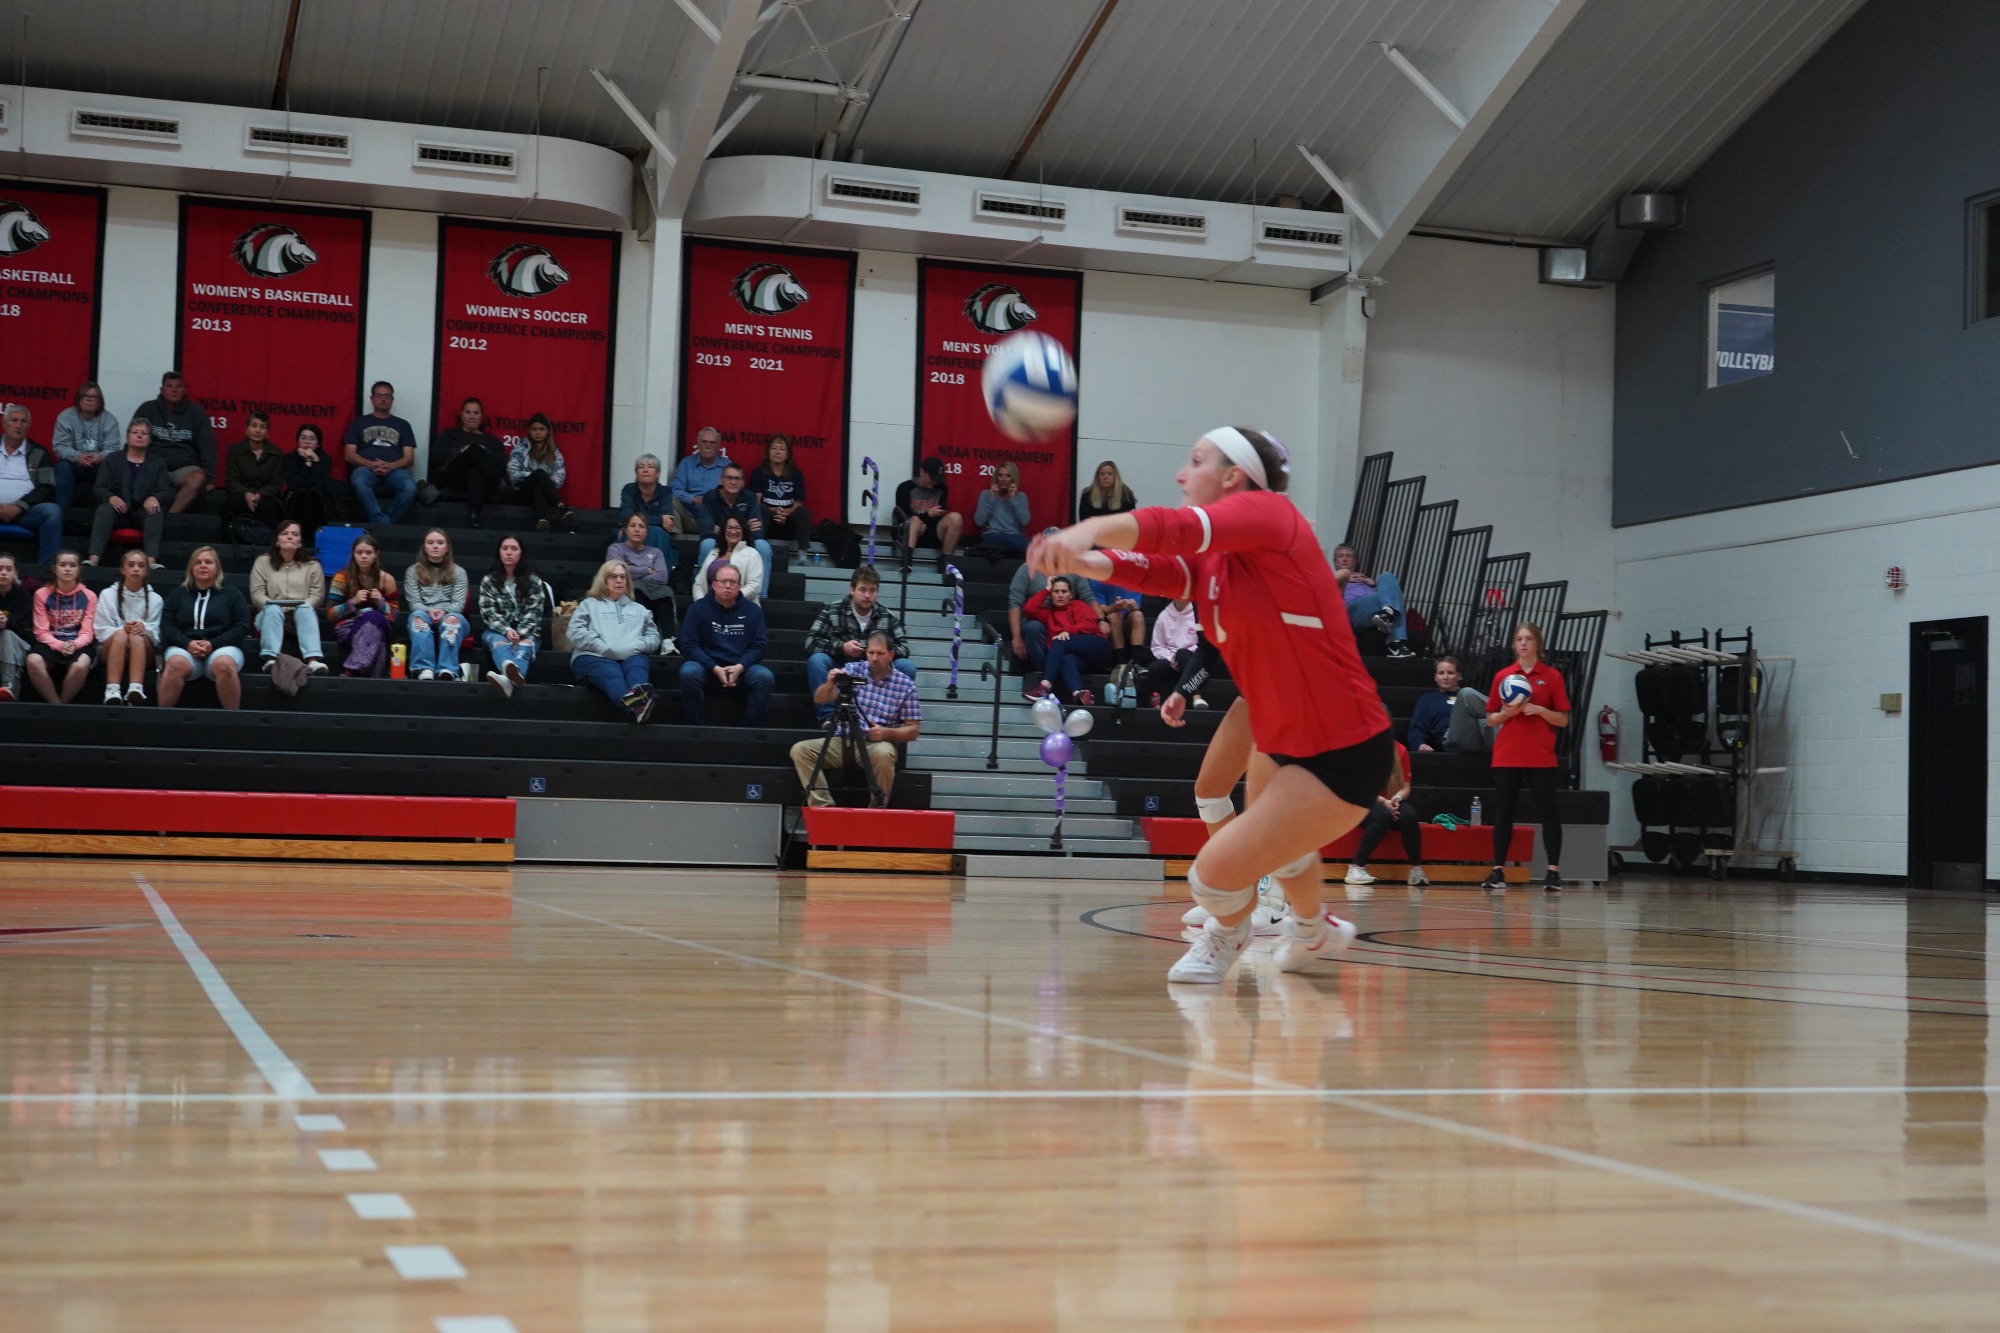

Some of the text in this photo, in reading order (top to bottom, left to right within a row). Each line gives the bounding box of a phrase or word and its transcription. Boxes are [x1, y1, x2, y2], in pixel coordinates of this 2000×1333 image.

[0, 269, 75, 285] SKETBALL
[7, 286, 90, 304] CHAMPIONS
[193, 283, 353, 306] WOMEN'S BASKETBALL
[0, 304, 21, 317] 18
[189, 301, 355, 324] CONFERENCE CHAMPIONS
[465, 304, 588, 324] WOMEN'S SOCCER
[192, 318, 232, 332] 2013
[446, 319, 606, 342] CONFERENCE CHAMPIONS
[724, 323, 813, 340] MEN'S TENNIS
[450, 336, 488, 350] 2012
[692, 336, 842, 359] CONFERENCE CHAMPIONS
[942, 340, 981, 354] MEN'S
[695, 353, 784, 371] 2019 2021
[930, 371, 965, 384] 2018
[240, 400, 336, 418] TOURNAMENT
[209, 416, 227, 429] 13
[502, 435, 520, 447] 20
[938, 445, 1055, 464] NCAA TOURNAMENT
[945, 463, 996, 476] 18 20
